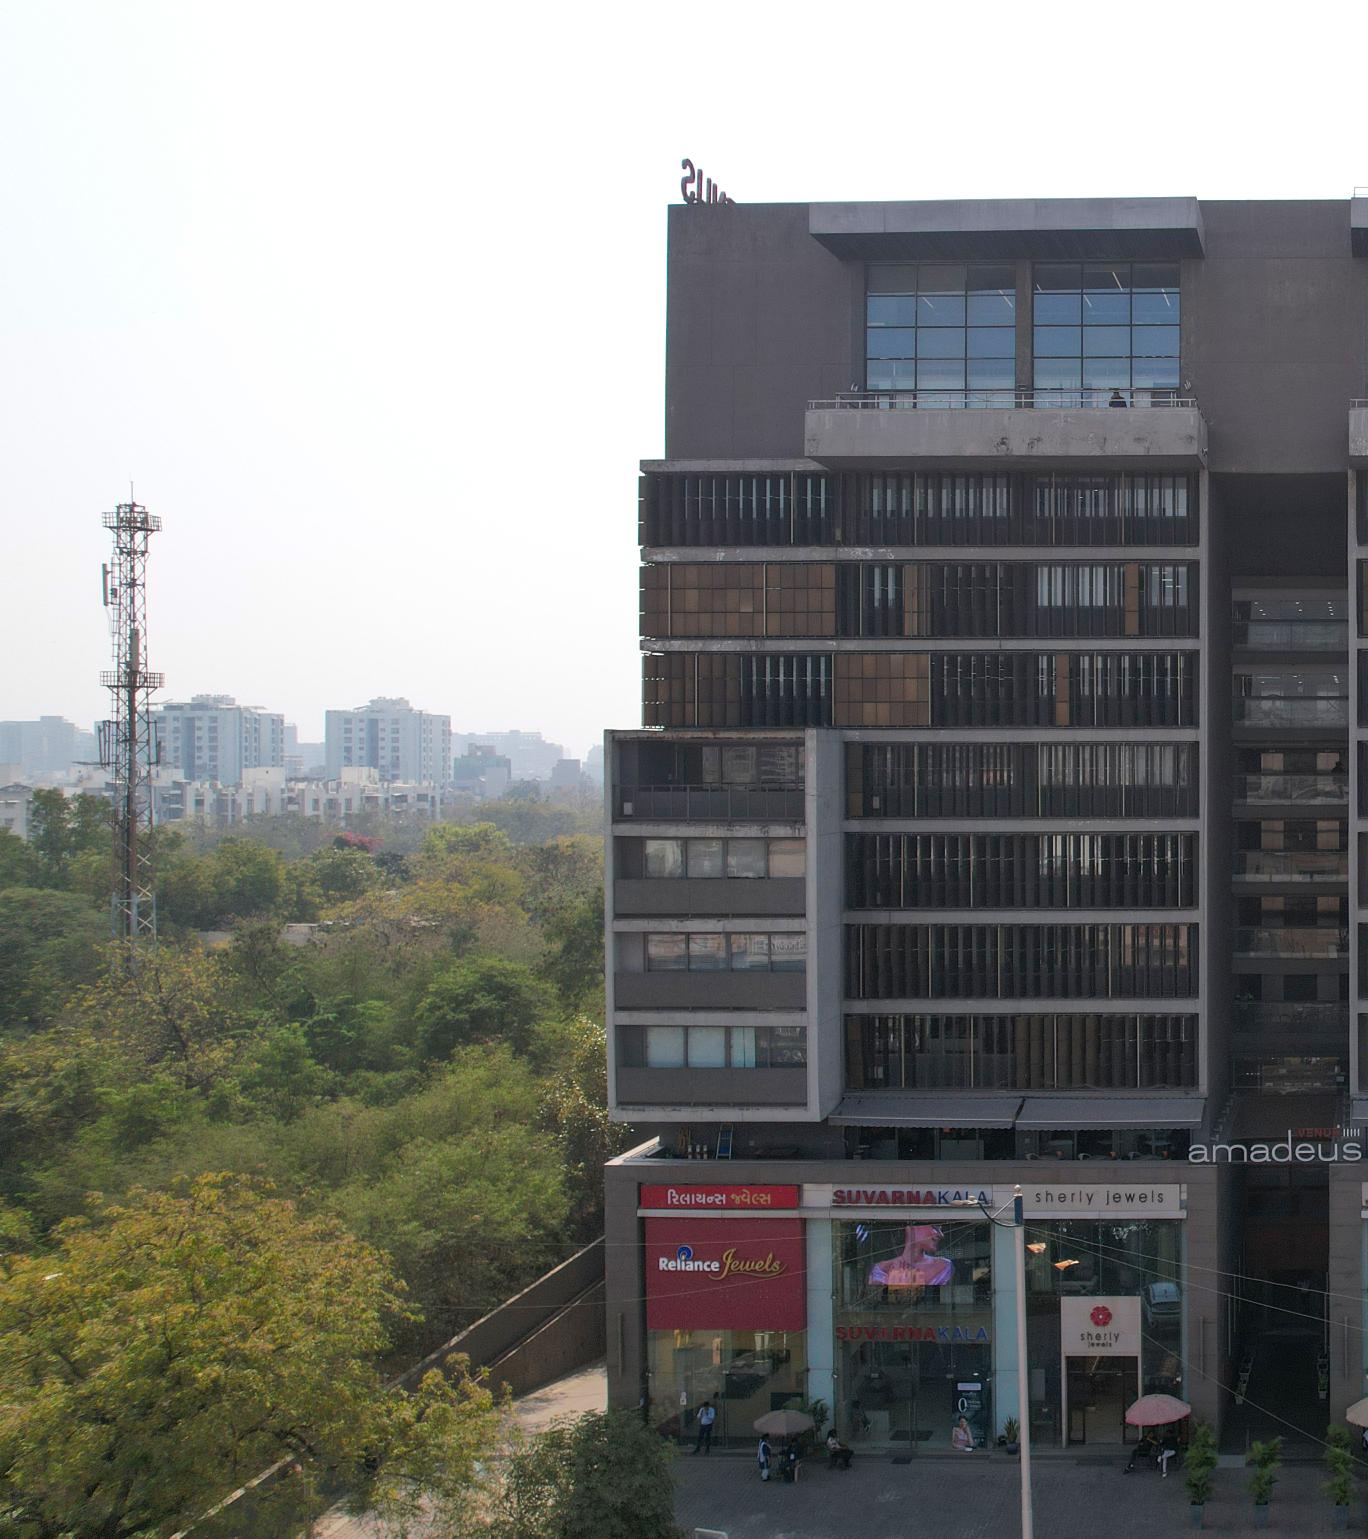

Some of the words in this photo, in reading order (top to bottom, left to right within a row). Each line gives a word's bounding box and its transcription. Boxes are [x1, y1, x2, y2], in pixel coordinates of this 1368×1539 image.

[1188, 1129, 1362, 1163] amadeus
[1035, 1190, 1094, 1206] sherly
[1105, 1190, 1164, 1206] jewels
[658, 1257, 720, 1272] Reliance
[708, 1248, 787, 1280] Jewels
[1080, 1331, 1120, 1343] sherly
